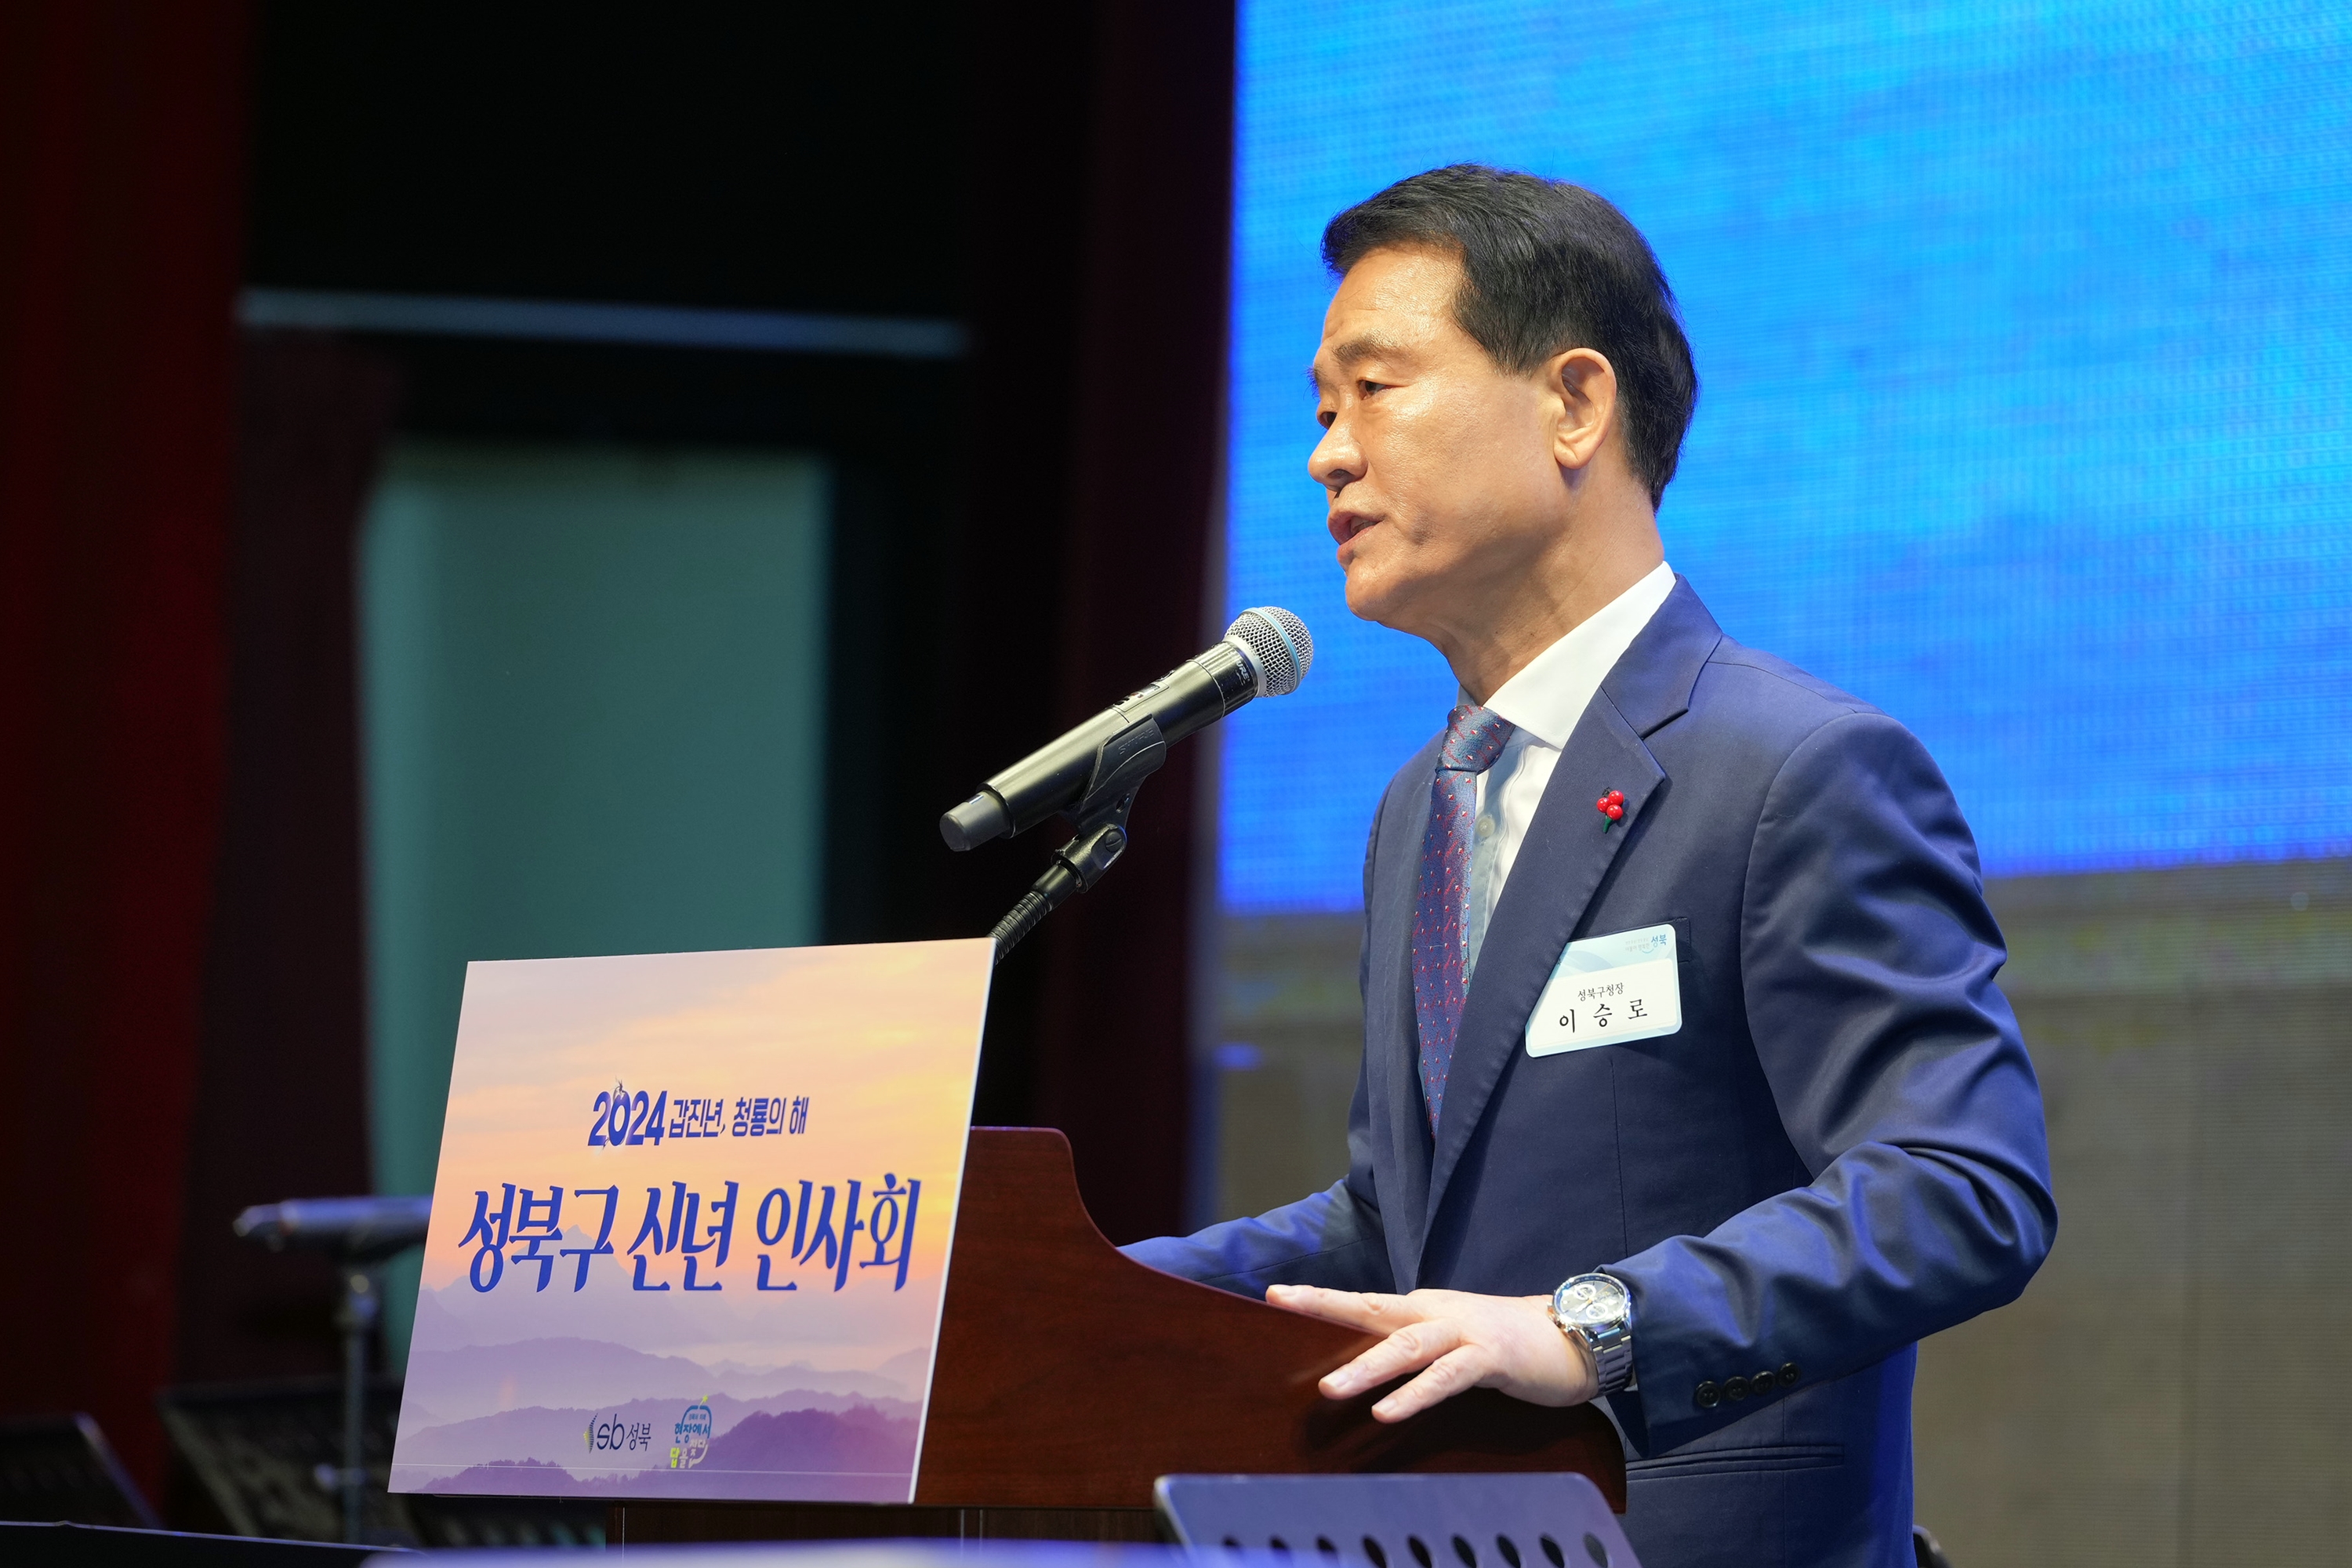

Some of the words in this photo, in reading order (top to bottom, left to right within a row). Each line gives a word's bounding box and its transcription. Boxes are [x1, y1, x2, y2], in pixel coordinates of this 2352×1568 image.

[1650, 934, 1668, 948] 성북
[1577, 982, 1624, 1001] 성북구청장
[587, 1090, 668, 1146] 2024
[669, 1098, 725, 1138] 갑진년,
[731, 1096, 787, 1137] 청룡의
[789, 1095, 810, 1134] 해
[458, 1182, 619, 1294] 성북구
[626, 1181, 739, 1292] 신년
[756, 1173, 922, 1293] 인사회
[597, 1414, 625, 1450] sb
[626, 1422, 652, 1451] 성북
[674, 1422, 712, 1443] 현장에서
[670, 1447, 688, 1468] 답을
